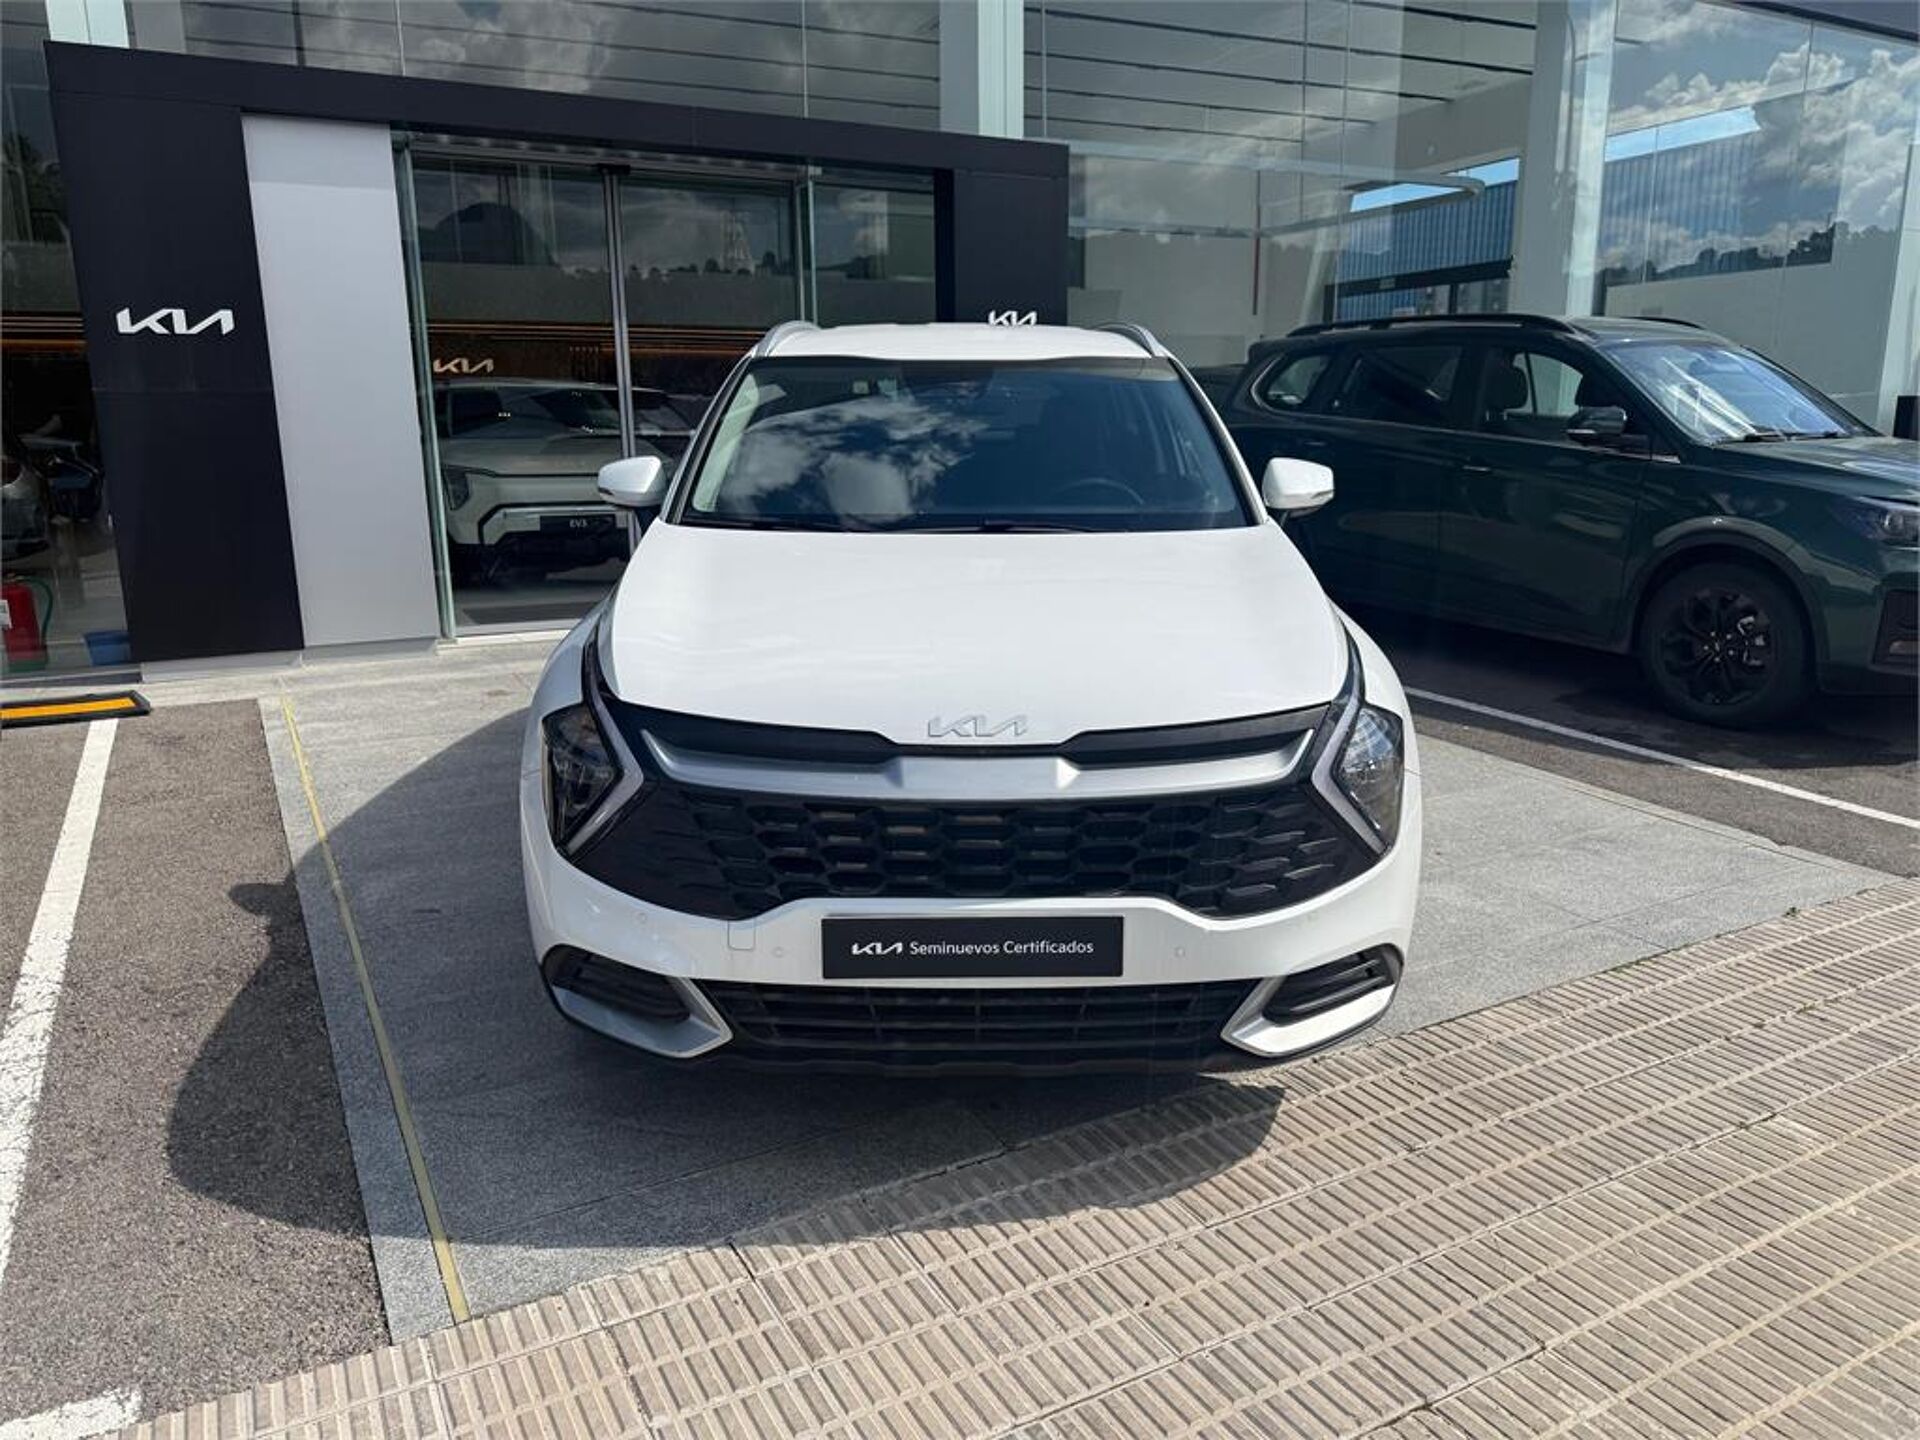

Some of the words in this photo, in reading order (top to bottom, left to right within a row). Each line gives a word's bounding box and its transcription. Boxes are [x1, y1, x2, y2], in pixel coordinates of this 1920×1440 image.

[116, 307, 235, 335] KIA
[988, 310, 1037, 326] KIA
[433, 358, 495, 373] KIA
[927, 715, 1028, 738] KIA
[851, 942, 903, 956] KIA
[909, 941, 1000, 955] Seminuevos
[1003, 940, 1095, 954] Certificados
